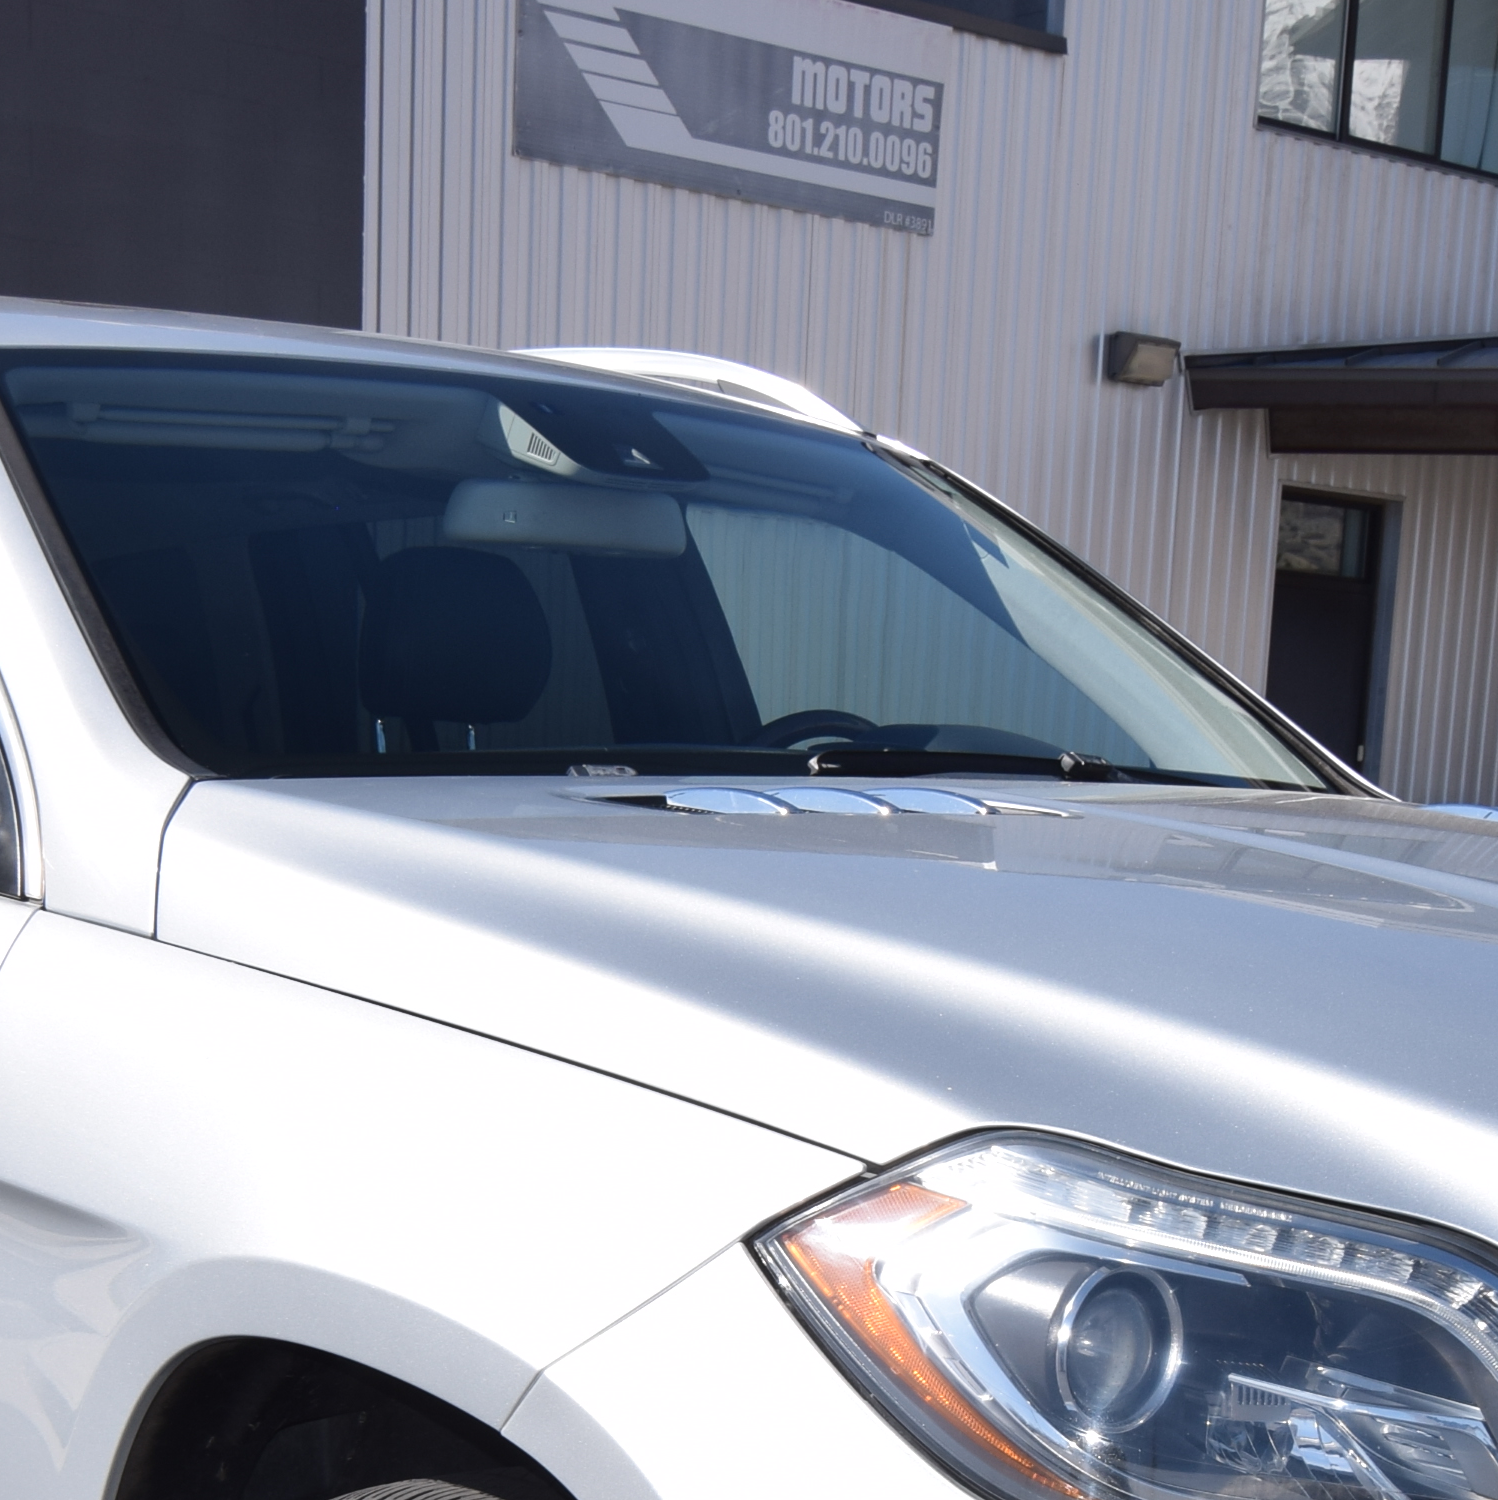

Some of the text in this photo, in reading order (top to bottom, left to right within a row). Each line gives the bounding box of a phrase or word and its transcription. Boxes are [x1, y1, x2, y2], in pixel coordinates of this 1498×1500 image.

[791, 55, 935, 133] MOTORS
[767, 109, 934, 180] 801.210.0096
[883, 210, 903, 226] DLR
